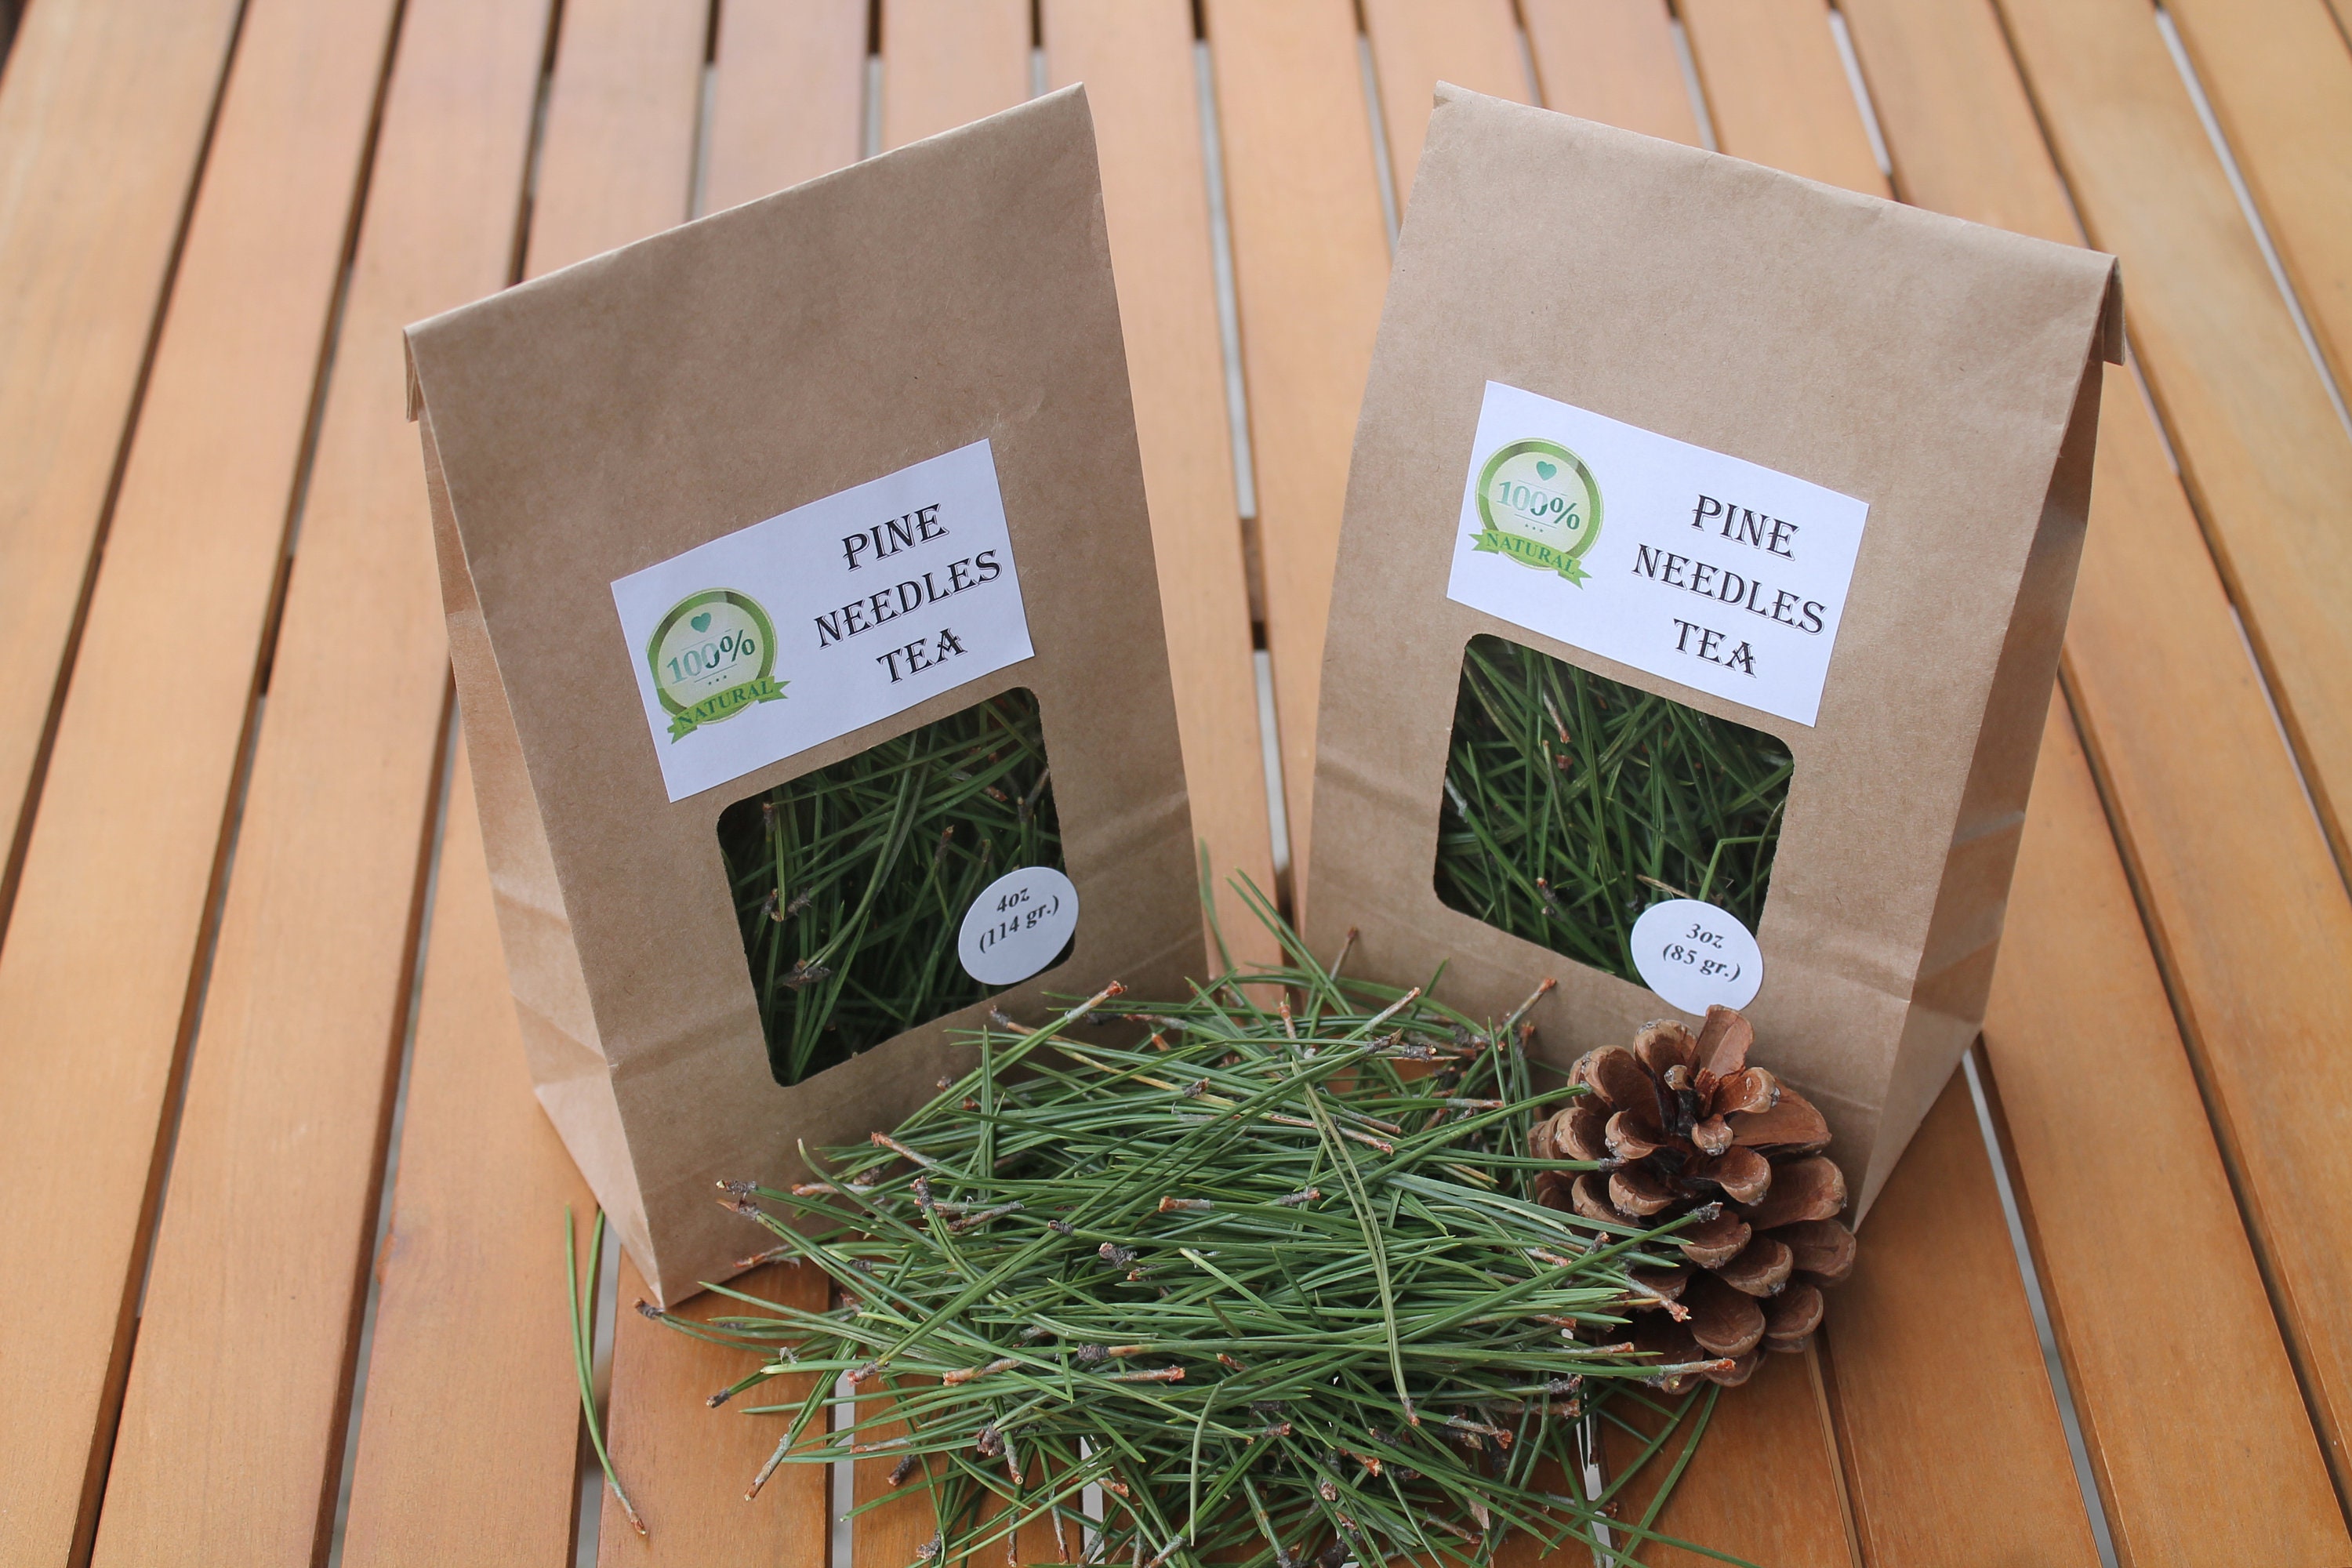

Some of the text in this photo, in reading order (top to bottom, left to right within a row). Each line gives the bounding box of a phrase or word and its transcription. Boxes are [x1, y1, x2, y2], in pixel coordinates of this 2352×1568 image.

[1496, 481, 1581, 530] 100%
[1690, 493, 1800, 562] PINE
[841, 503, 950, 572] PINE
[1486, 532, 1575, 575] NATURAL
[813, 549, 1003, 651] NEEDLES
[1631, 543, 1828, 636] NEEDLES
[666, 629, 756, 684] 100%
[875, 627, 968, 685] TEA
[1672, 618, 1757, 679] TEA
[677, 681, 774, 731] NATURAL
[979, 895, 1060, 954] (114 gr.)
[996, 887, 1030, 913] 4oz
[1662, 942, 1741, 982] (85 gr.)
[1686, 923, 1725, 949] 3oz
